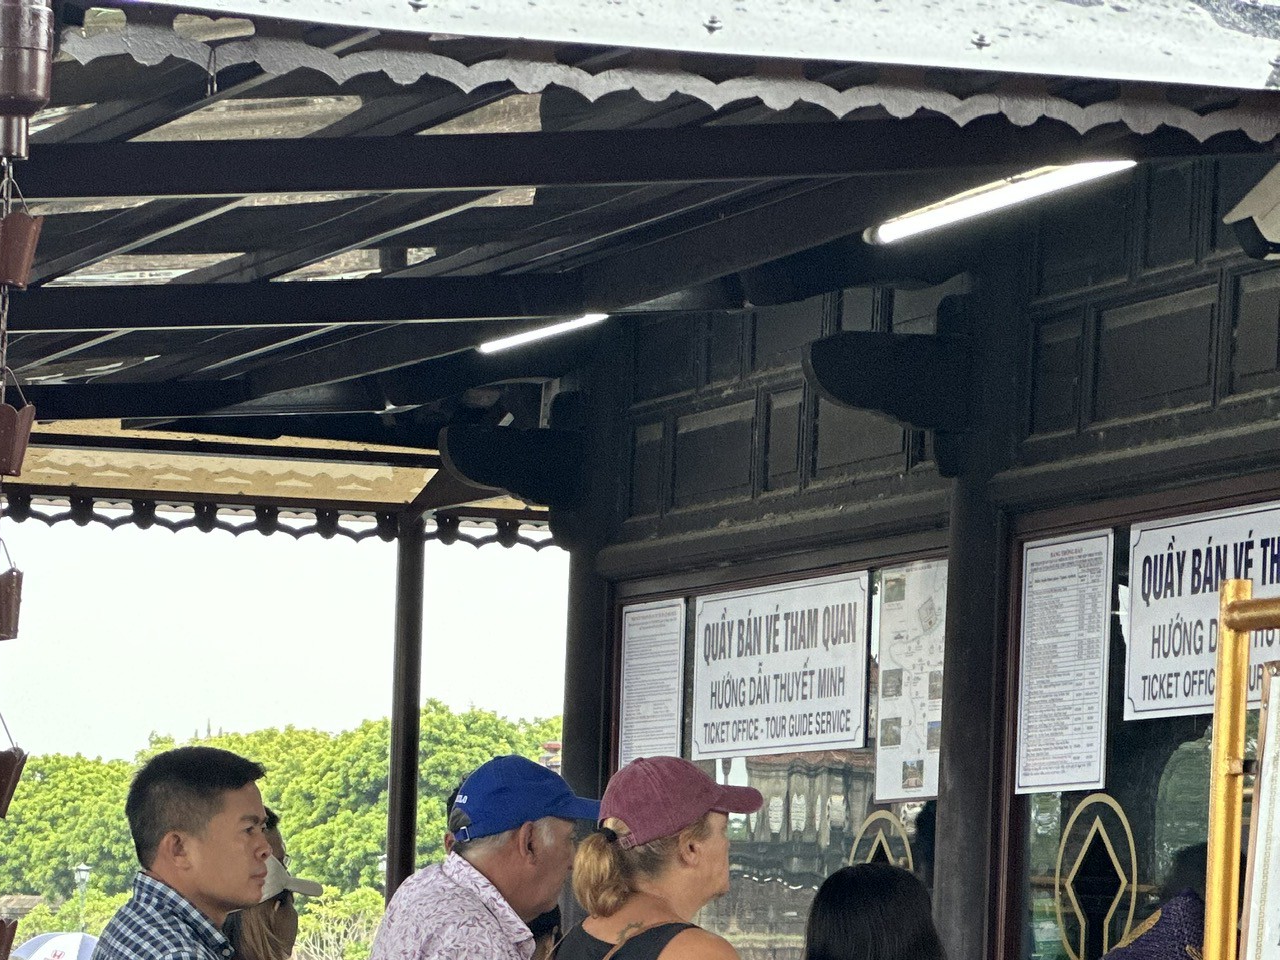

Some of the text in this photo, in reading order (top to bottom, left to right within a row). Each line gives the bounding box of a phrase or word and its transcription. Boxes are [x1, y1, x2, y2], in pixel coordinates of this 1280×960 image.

[1142, 535, 1186, 607] QUẦY
[1191, 536, 1228, 595] BÁN
[704, 602, 857, 666] QUẦY BÁN VÉ THAM QUAN
[1151, 613, 1203, 659] HƯỚNG
[710, 657, 845, 710] HƯỚNG DẪN THUYẾT MINH
[1142, 672, 1180, 701] TICKET
[704, 720, 730, 744] TICKET
[732, 718, 759, 742] OFFICE
[765, 716, 787, 739] TOUR
[788, 713, 813, 737] GUIDE
[815, 709, 851, 734] SERVICE
